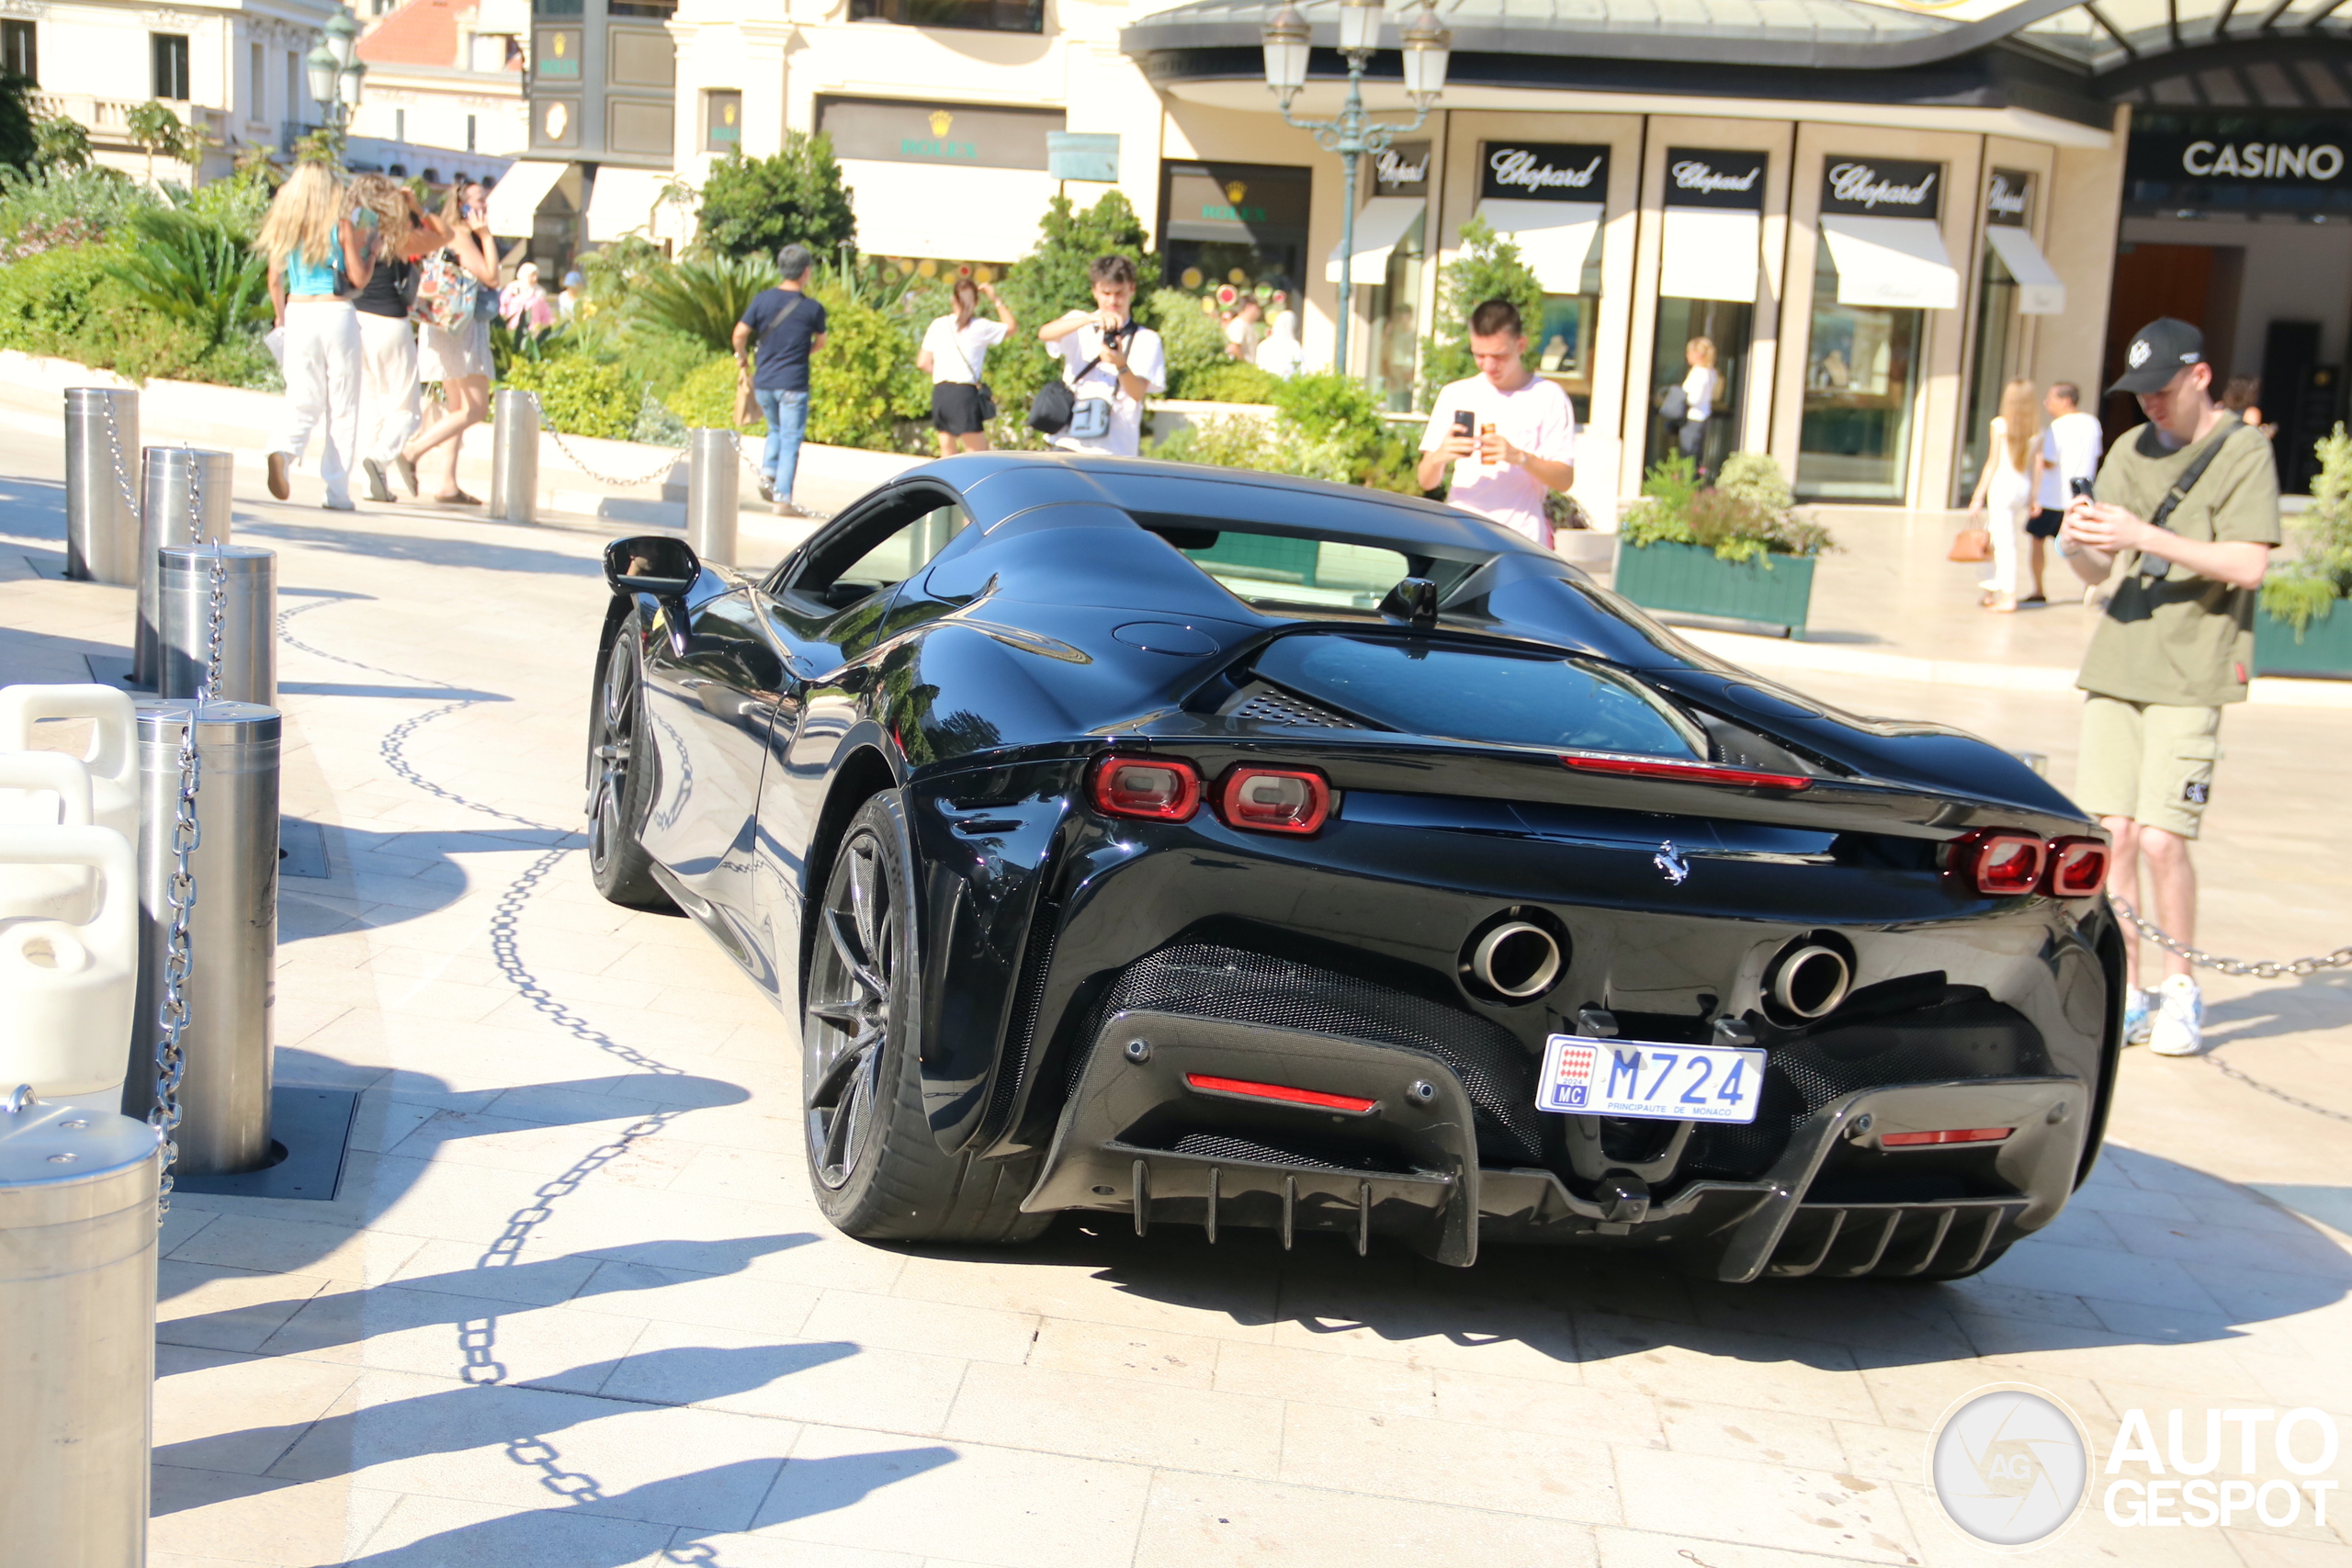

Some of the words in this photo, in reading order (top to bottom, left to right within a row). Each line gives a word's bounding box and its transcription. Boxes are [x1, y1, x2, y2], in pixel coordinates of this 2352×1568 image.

[901, 139, 978, 160] ROLEX
[2182, 141, 2345, 181] CASINO
[1490, 149, 1602, 194] Chopard
[1672, 160, 1761, 195] Chopard
[1829, 163, 1936, 209] Chopard
[1201, 204, 1268, 222] ROLEX
[1558, 1086, 1583, 1103] MC
[1606, 1049, 1745, 1106] M724
[1607, 1101, 1667, 1113] PRINCIPAUTE
[1673, 1106, 1686, 1114] DE
[1692, 1107, 1732, 1117] MONACO
